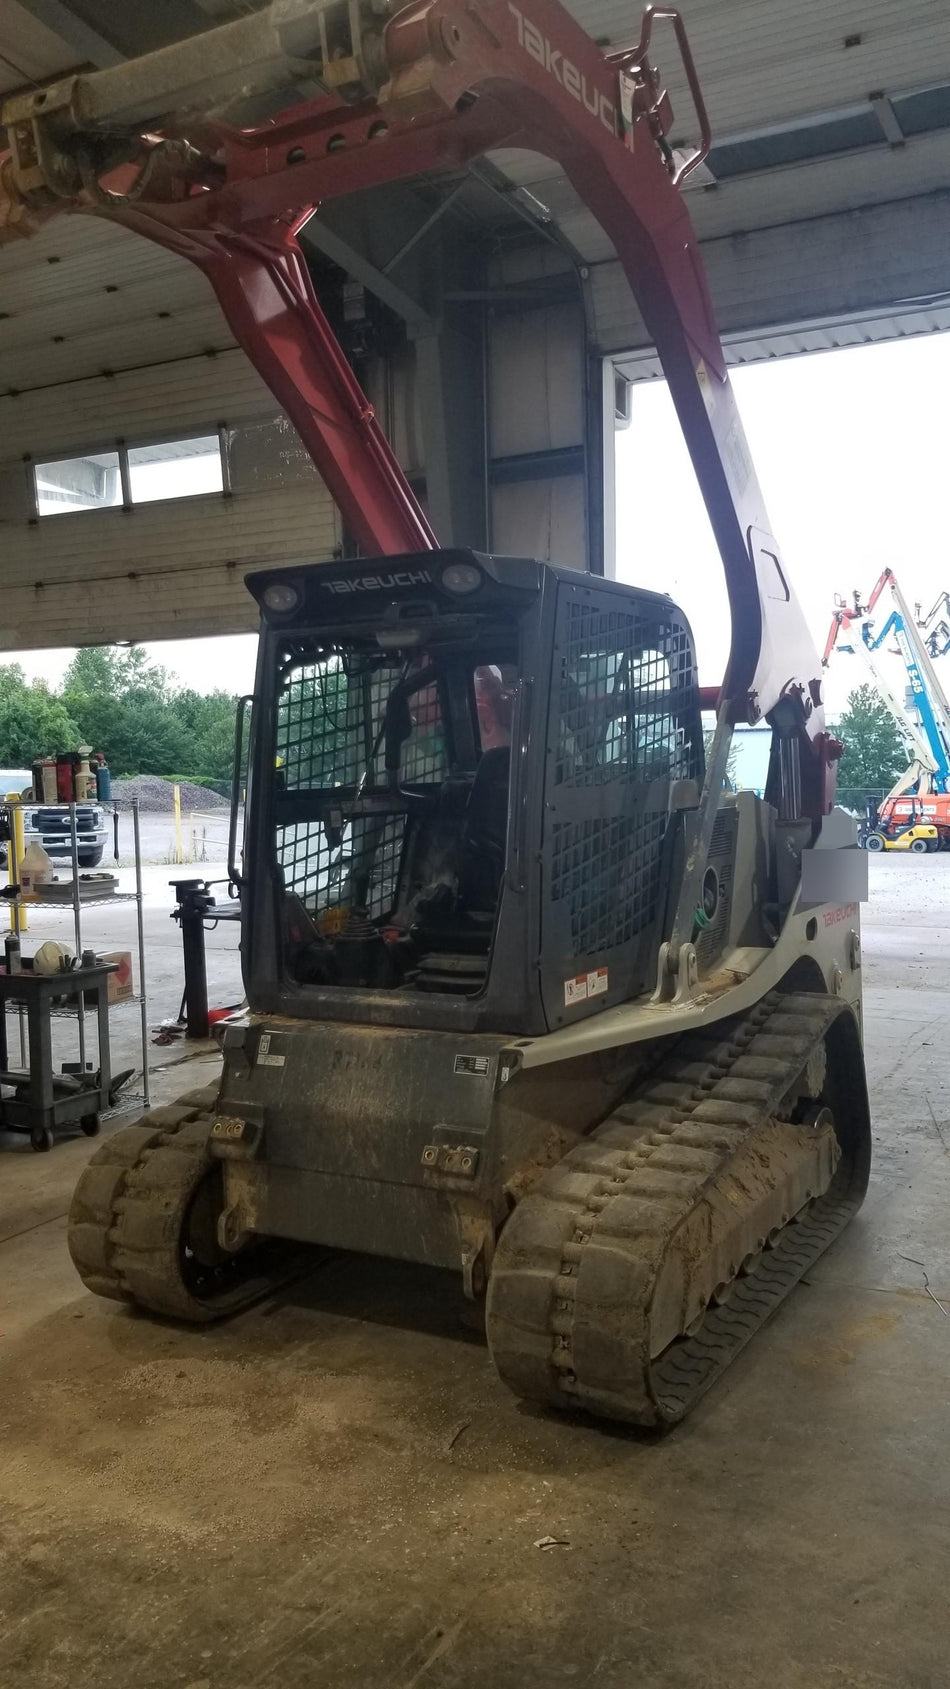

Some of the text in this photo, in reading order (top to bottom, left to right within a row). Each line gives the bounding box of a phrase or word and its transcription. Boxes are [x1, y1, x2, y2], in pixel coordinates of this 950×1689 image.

[909, 669, 924, 694] S-65
[896, 716, 916, 742] JLG LIFT
